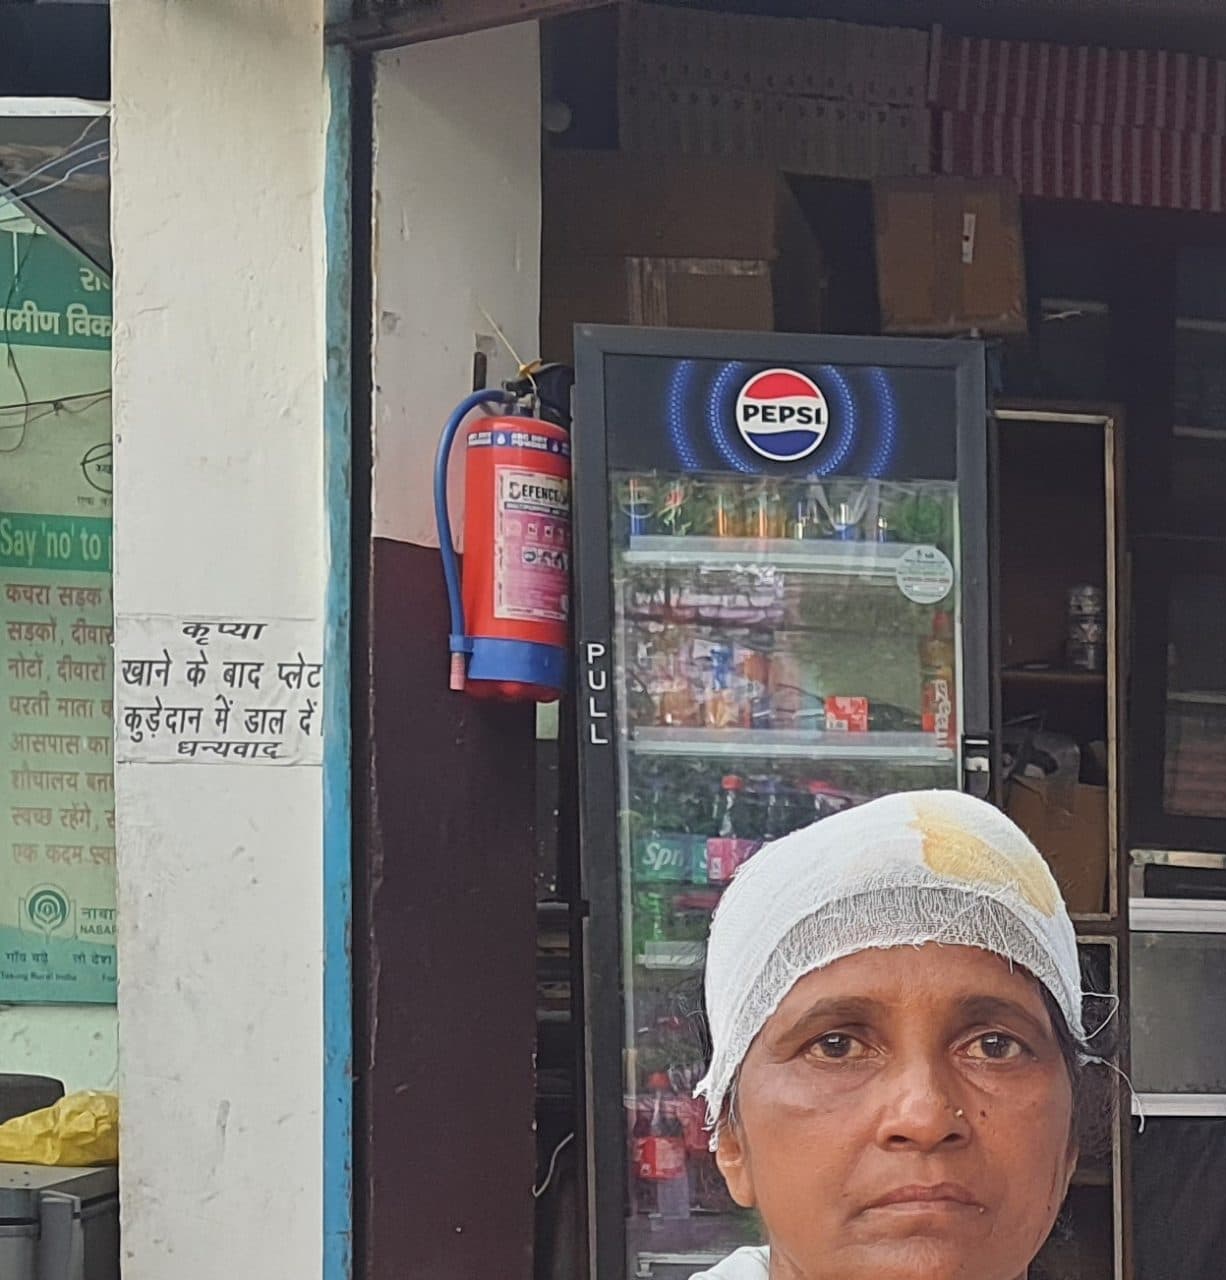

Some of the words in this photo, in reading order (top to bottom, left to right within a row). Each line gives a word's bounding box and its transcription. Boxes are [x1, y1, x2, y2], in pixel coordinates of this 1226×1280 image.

[743, 404, 822, 425] PEPSI
[1, 518, 36, 567] Say
[80, 527, 101, 561] to
[122, 649, 171, 687] खाने
[186, 650, 208, 687] के
[223, 662, 264, 689] बाद
[277, 652, 322, 689] प्लेट
[587, 643, 608, 744] PULL
[124, 696, 203, 743] कुड़ेदान
[215, 694, 233, 734] में
[244, 709, 287, 734] डाल
[178, 741, 282, 759] धन्यवाद
